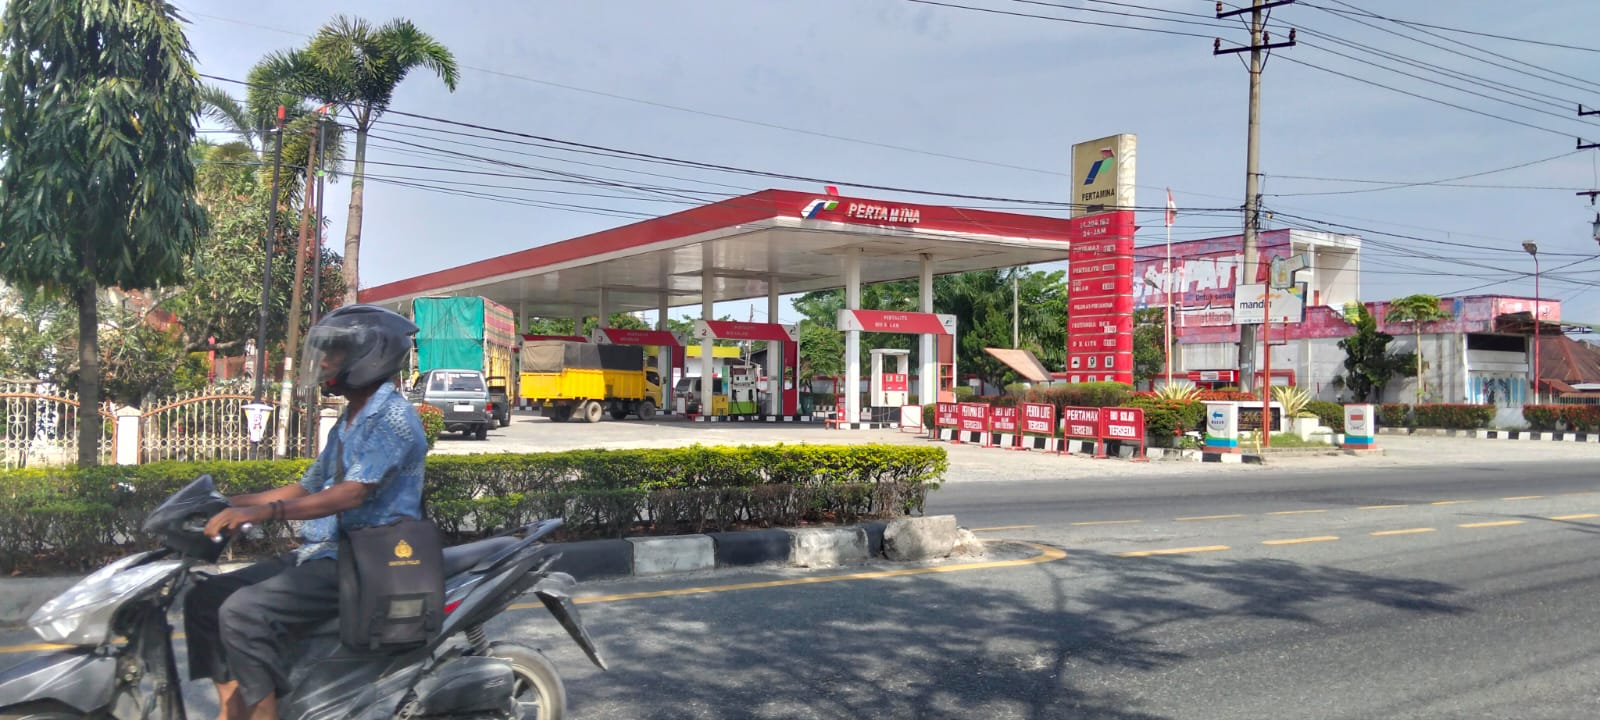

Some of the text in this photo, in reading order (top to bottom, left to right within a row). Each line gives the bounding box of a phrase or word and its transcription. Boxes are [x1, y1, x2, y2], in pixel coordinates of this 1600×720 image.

[1081, 188, 1115, 201] PERTAMINA
[848, 203, 920, 223] PERTAMINA
[1239, 300, 1272, 309] mandi
[1066, 409, 1099, 422] PERTAMAX
